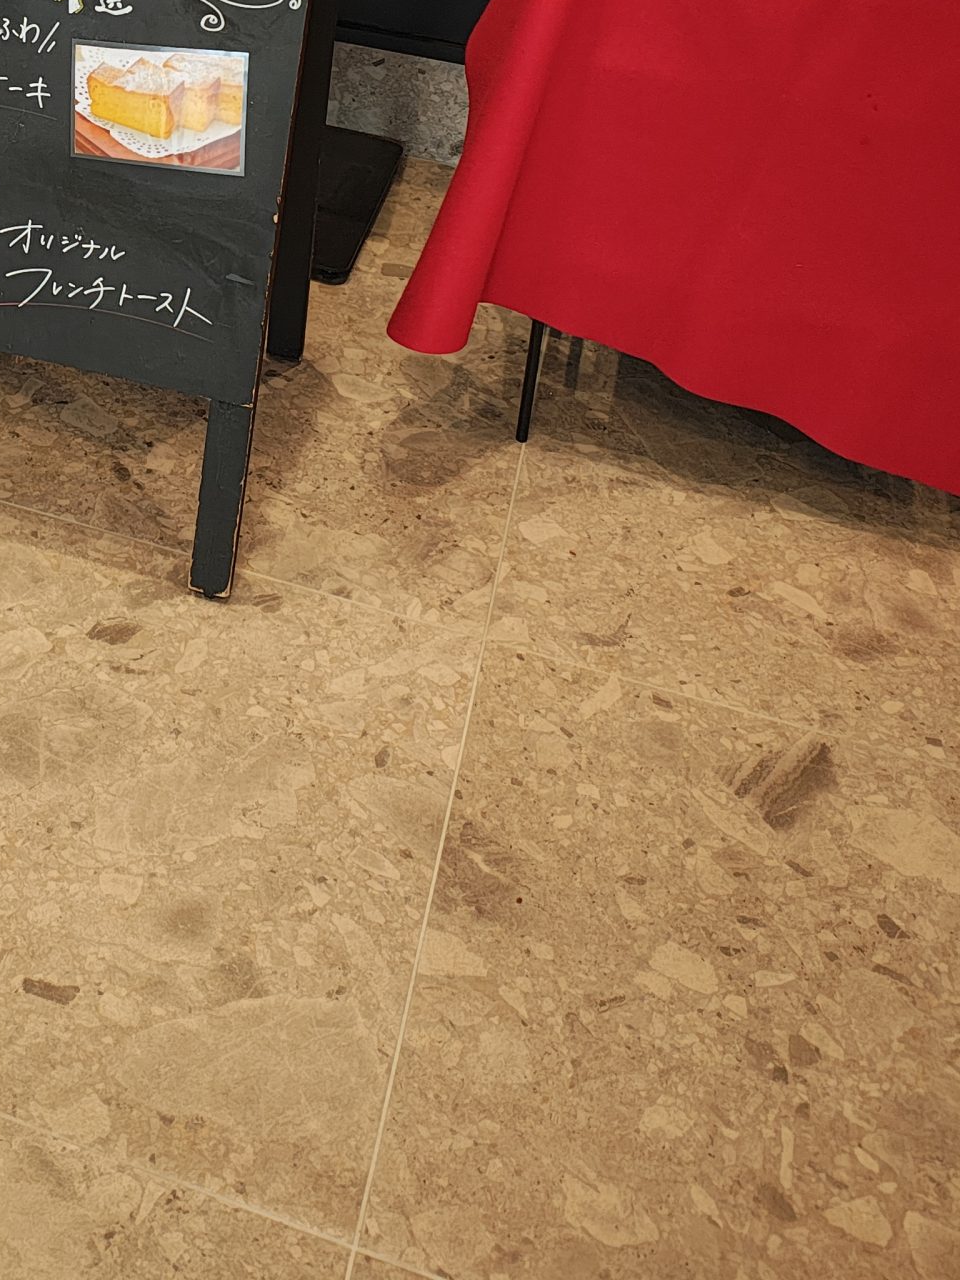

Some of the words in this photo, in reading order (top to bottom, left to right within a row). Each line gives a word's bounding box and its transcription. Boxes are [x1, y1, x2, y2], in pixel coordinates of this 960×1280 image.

[0, 219, 126, 262] オリジナル
[5, 267, 213, 328] フレンチトースト
